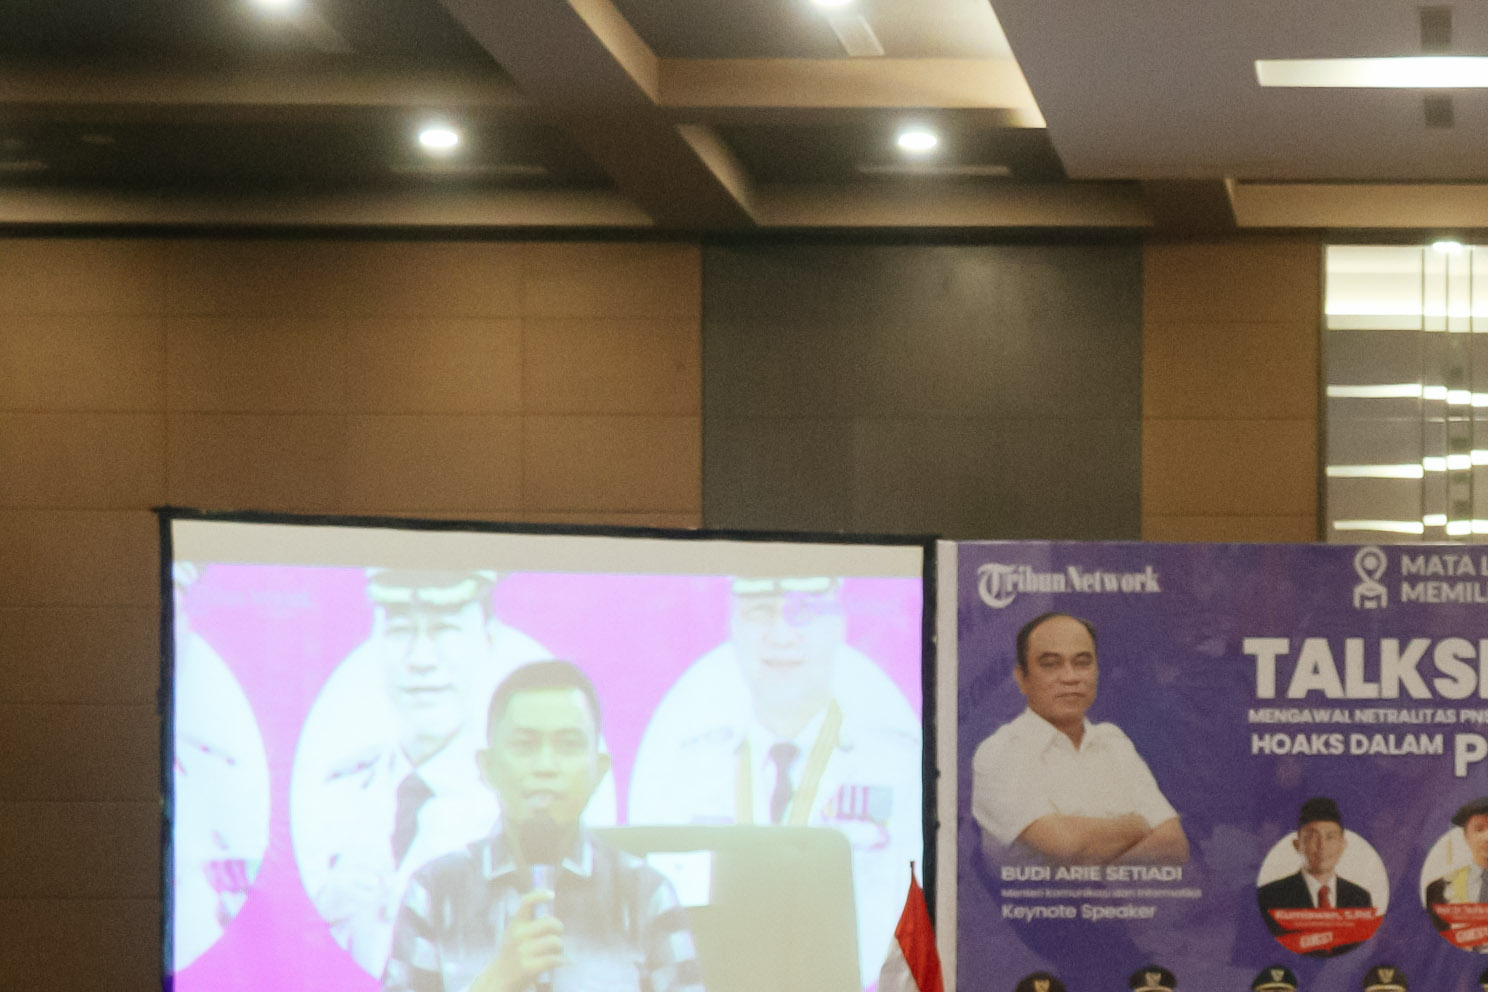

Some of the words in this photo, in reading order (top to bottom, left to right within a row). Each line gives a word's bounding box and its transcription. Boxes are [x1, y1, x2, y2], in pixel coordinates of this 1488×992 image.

[1401, 554, 1476, 577] MATA
[1248, 708, 1351, 724] MENGAWAL
[1354, 708, 1457, 724] NETRALITAS
[1251, 733, 1345, 755] HOAKS
[1350, 733, 1444, 755] DALAM
[1001, 865, 1051, 882] BUDI
[1055, 866, 1101, 882] ARIE
[1105, 866, 1183, 882] SETIADI
[1001, 903, 1077, 922] Keynote
[1081, 903, 1157, 922] Speaker
